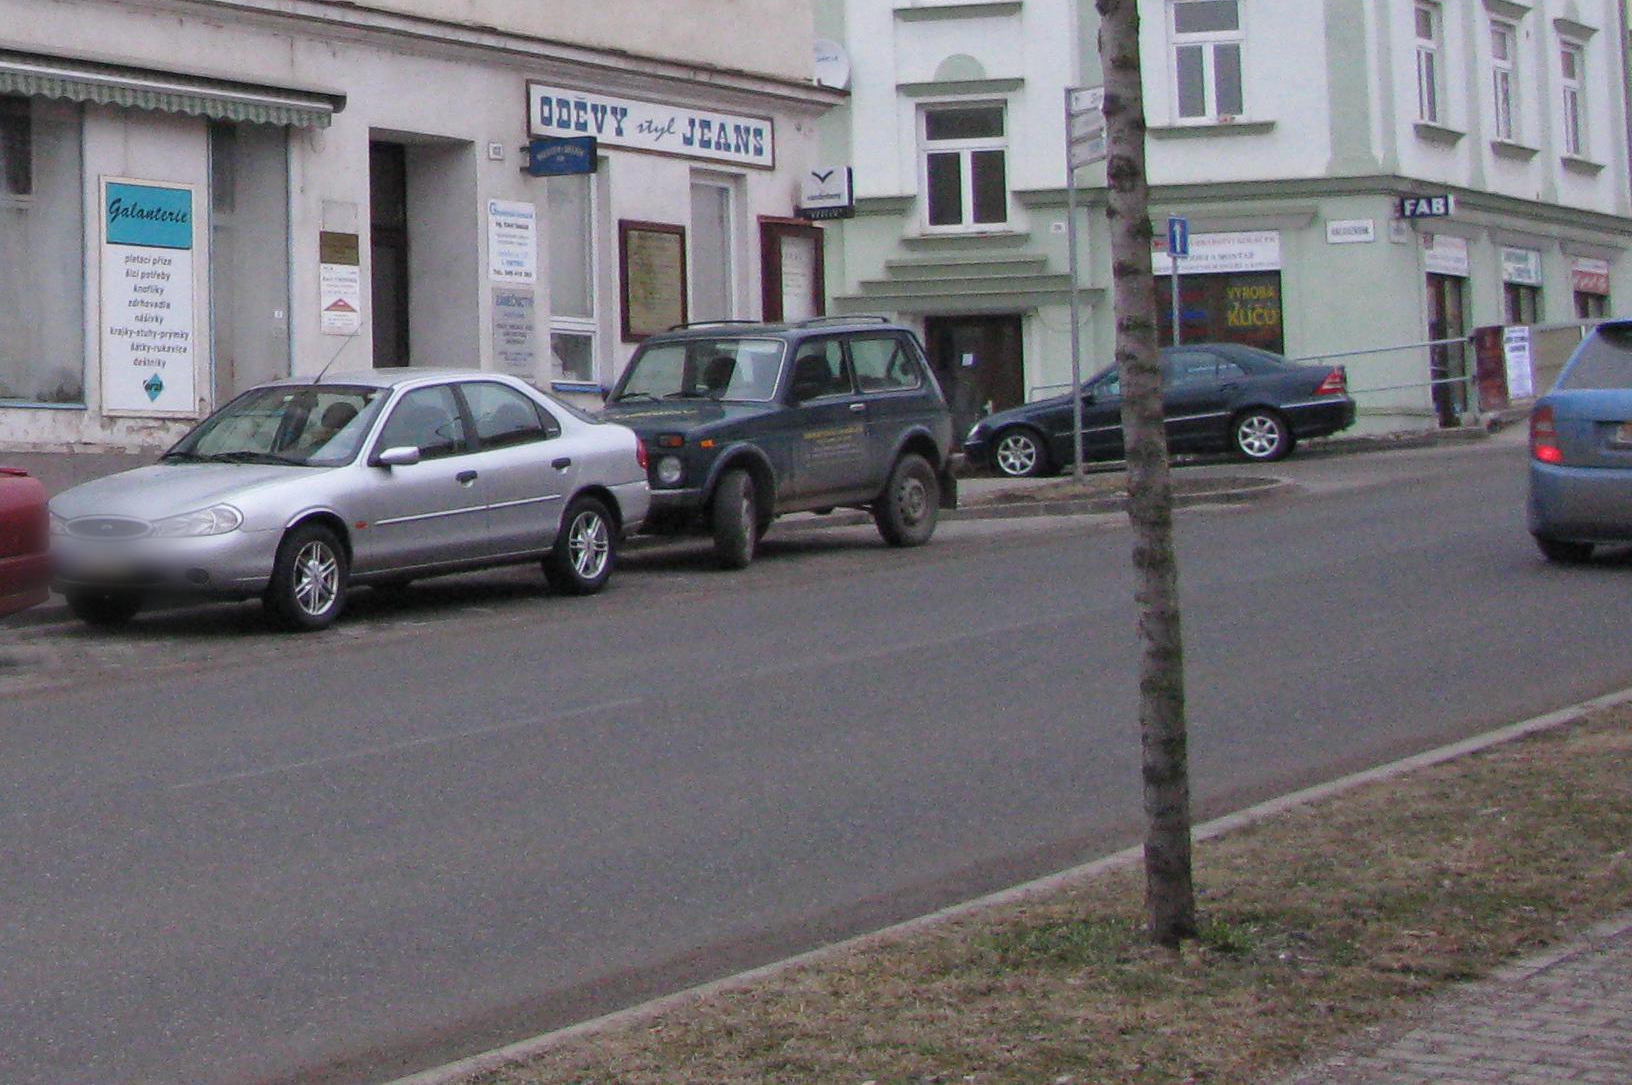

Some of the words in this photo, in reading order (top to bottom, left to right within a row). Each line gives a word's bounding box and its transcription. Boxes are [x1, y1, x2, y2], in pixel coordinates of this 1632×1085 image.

[540, 96, 628, 137] ODĚVY
[637, 116, 676, 142] styl
[682, 117, 764, 157] JEANS
[109, 197, 189, 224] Galanterie
[1403, 198, 1445, 216] FAB
